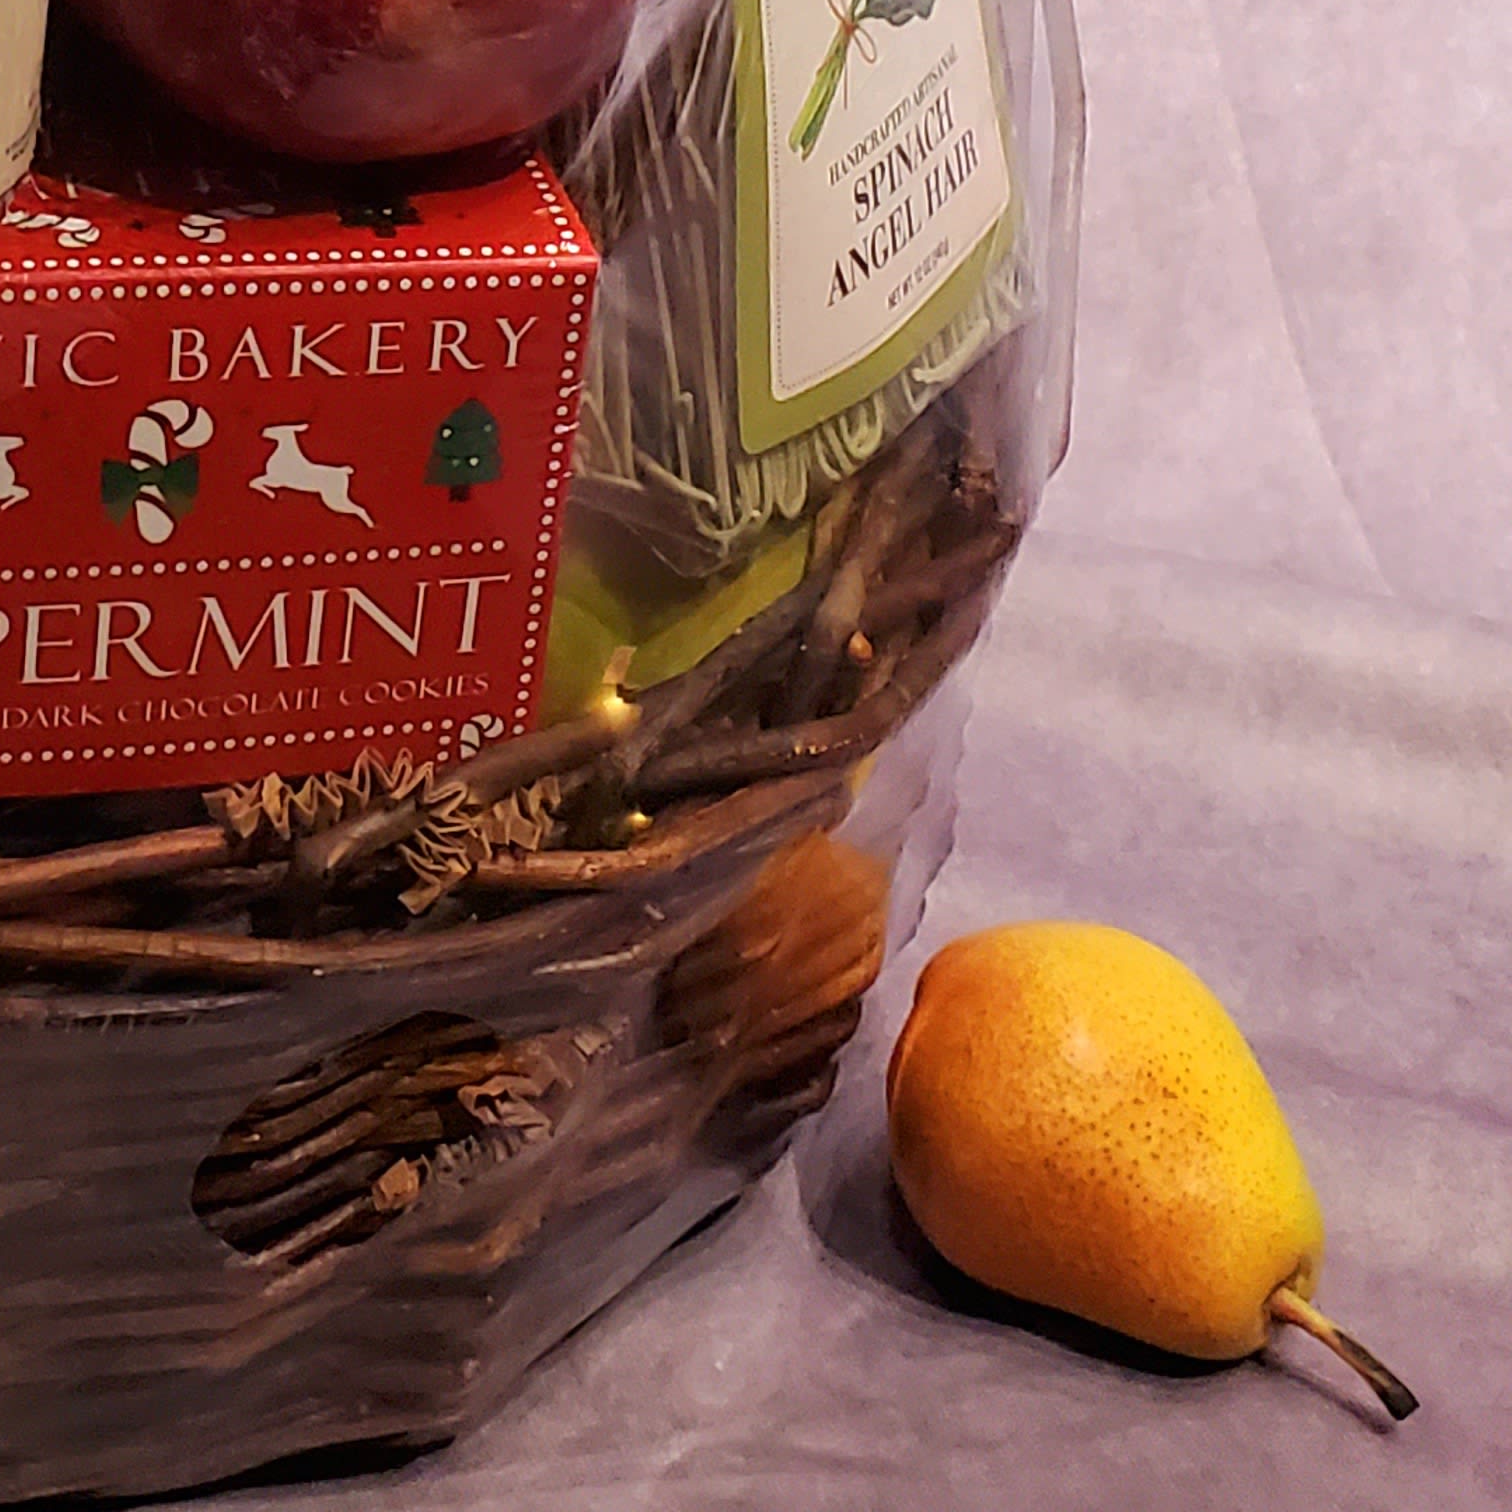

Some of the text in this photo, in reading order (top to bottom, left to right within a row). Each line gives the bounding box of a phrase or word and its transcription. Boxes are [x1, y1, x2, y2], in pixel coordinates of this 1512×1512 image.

[854, 87, 955, 226] SPINACH
[826, 128, 979, 308] ANGEL HAIR
[166, 316, 539, 383] BAKERY
[1, 703, 104, 731] DARK
[116, 687, 321, 724] CHOCOLATE
[338, 672, 490, 707] COOKIES
